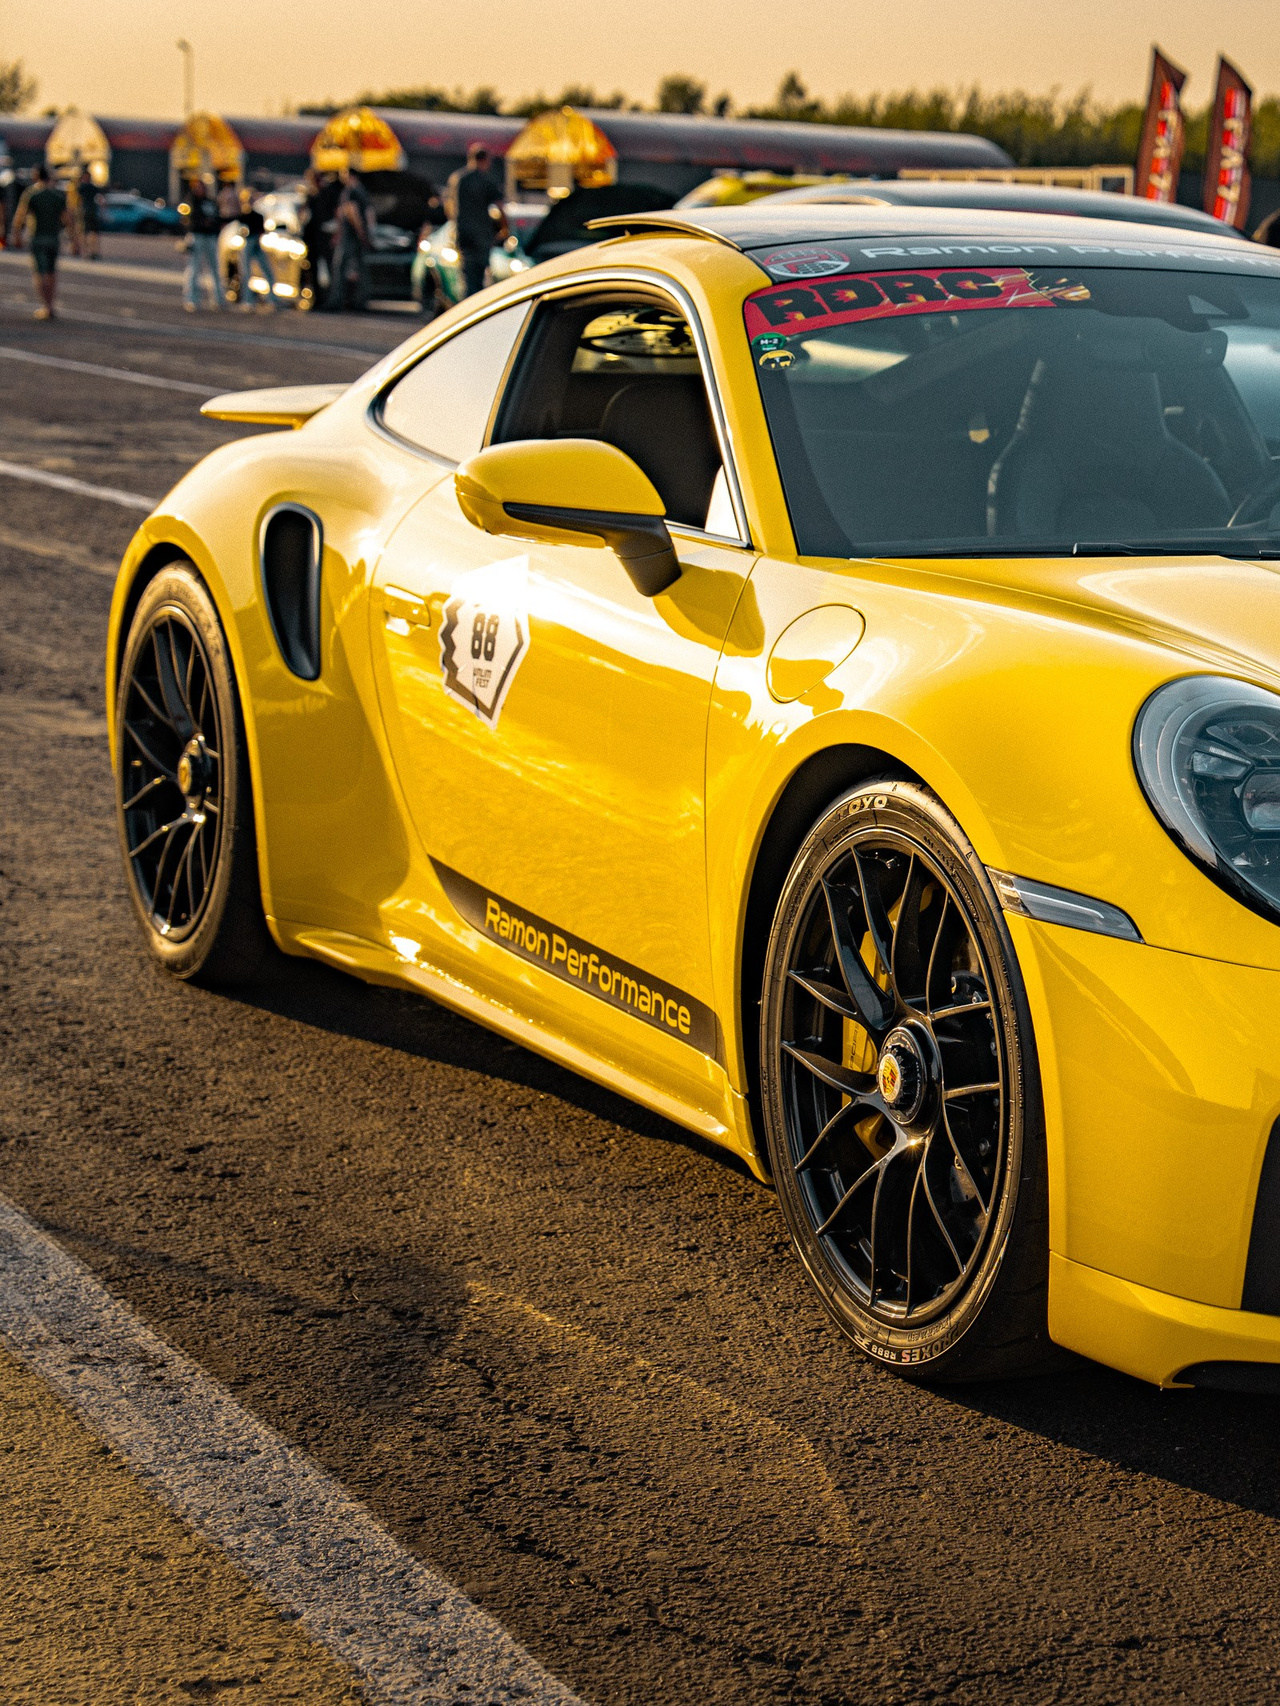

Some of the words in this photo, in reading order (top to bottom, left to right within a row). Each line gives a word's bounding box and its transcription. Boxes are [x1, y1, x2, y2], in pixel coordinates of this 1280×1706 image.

[859, 245, 1058, 259] Ramon
[471, 612, 500, 662] 88
[485, 898, 550, 960] Ramon
[551, 933, 691, 1035] Performance
[901, 1322, 961, 1363] PROXES
